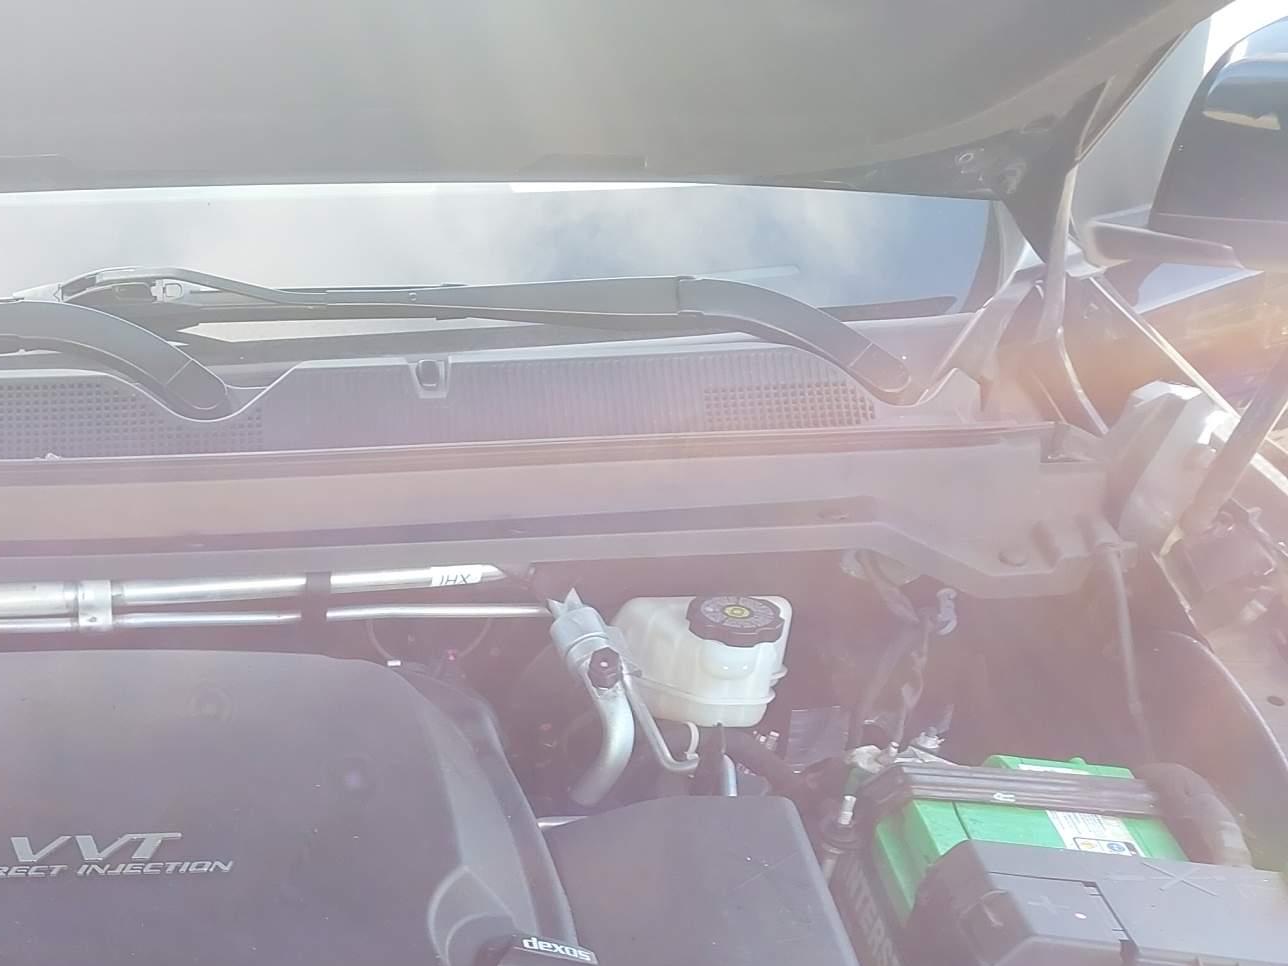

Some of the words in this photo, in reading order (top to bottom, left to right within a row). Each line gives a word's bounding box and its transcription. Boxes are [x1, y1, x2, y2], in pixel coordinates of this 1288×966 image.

[11, 832, 182, 862] VVT
[76, 860, 233, 876] INJECTION
[522, 936, 592, 961] dexos
